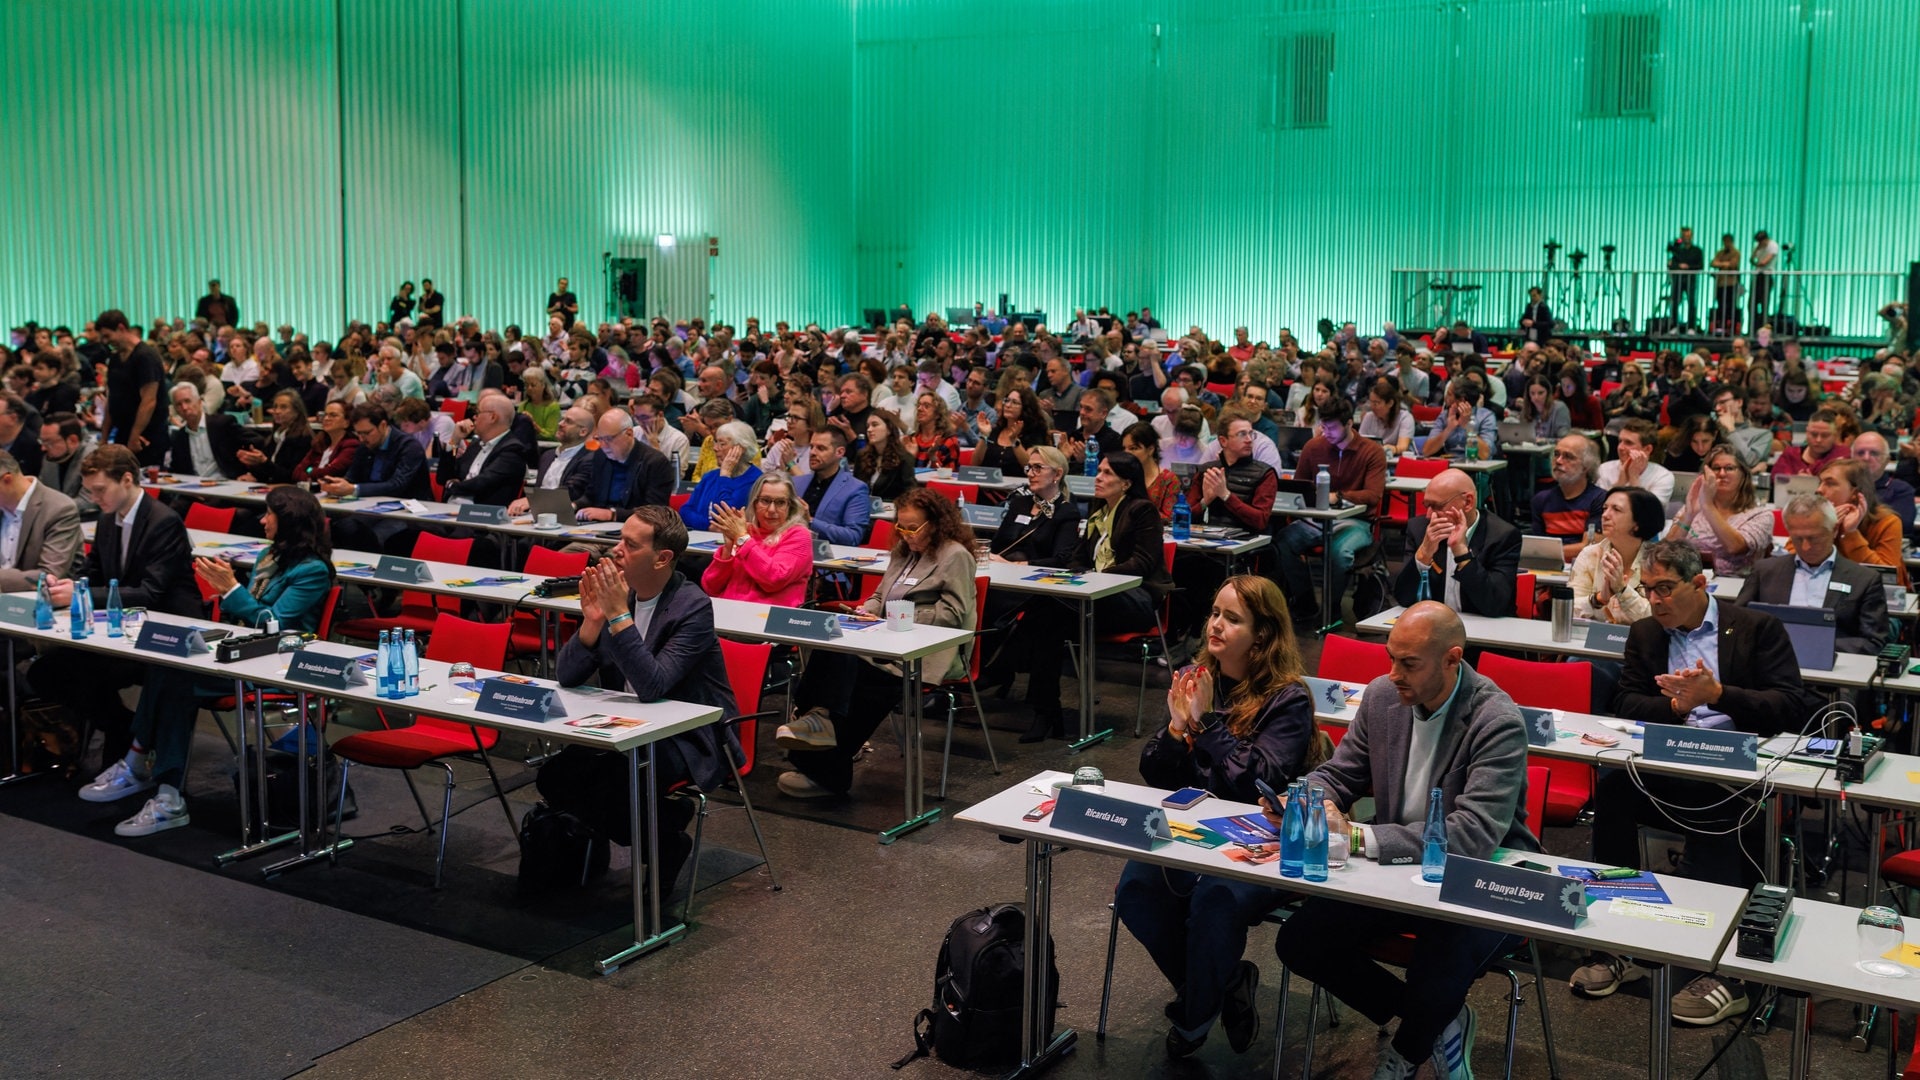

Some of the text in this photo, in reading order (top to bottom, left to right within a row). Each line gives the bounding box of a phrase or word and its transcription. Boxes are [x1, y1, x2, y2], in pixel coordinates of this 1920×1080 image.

[1666, 739, 1734, 753] Dr. Andre Baumann
[1085, 807, 1129, 826] Ricarda Lang
[1474, 878, 1487, 889] Dr.
[1488, 881, 1518, 896] Danyal
[1518, 887, 1545, 901] Bayaz
